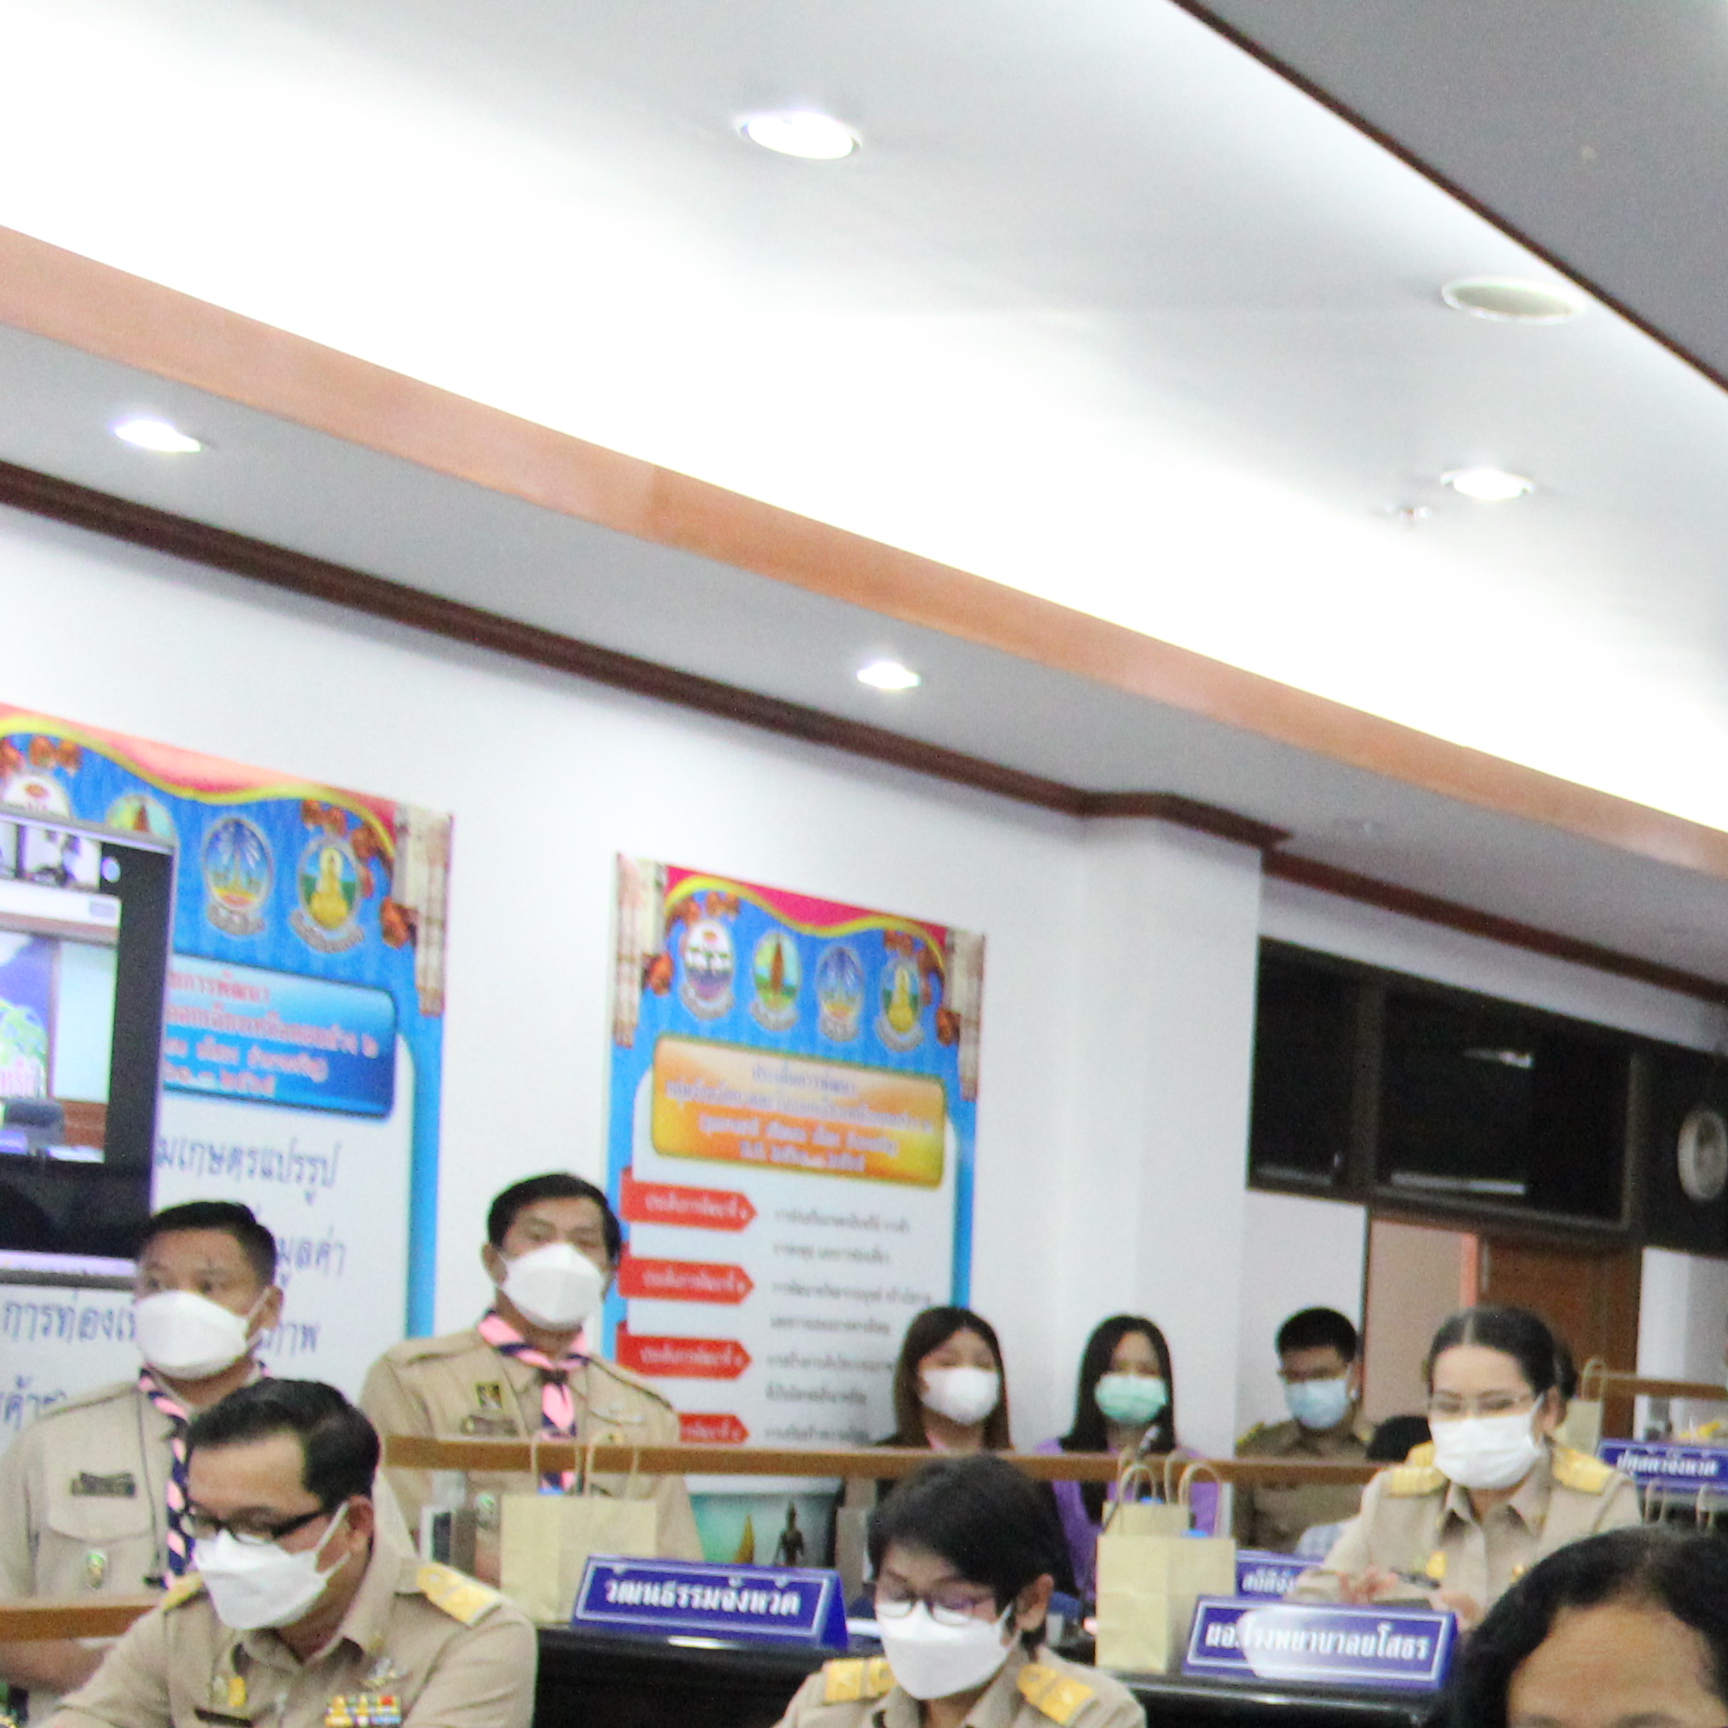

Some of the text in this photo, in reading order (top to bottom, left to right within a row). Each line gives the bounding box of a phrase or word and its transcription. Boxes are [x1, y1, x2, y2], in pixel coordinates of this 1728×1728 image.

[604, 1565, 801, 1617] วัฒนธรรมจังหวัด
